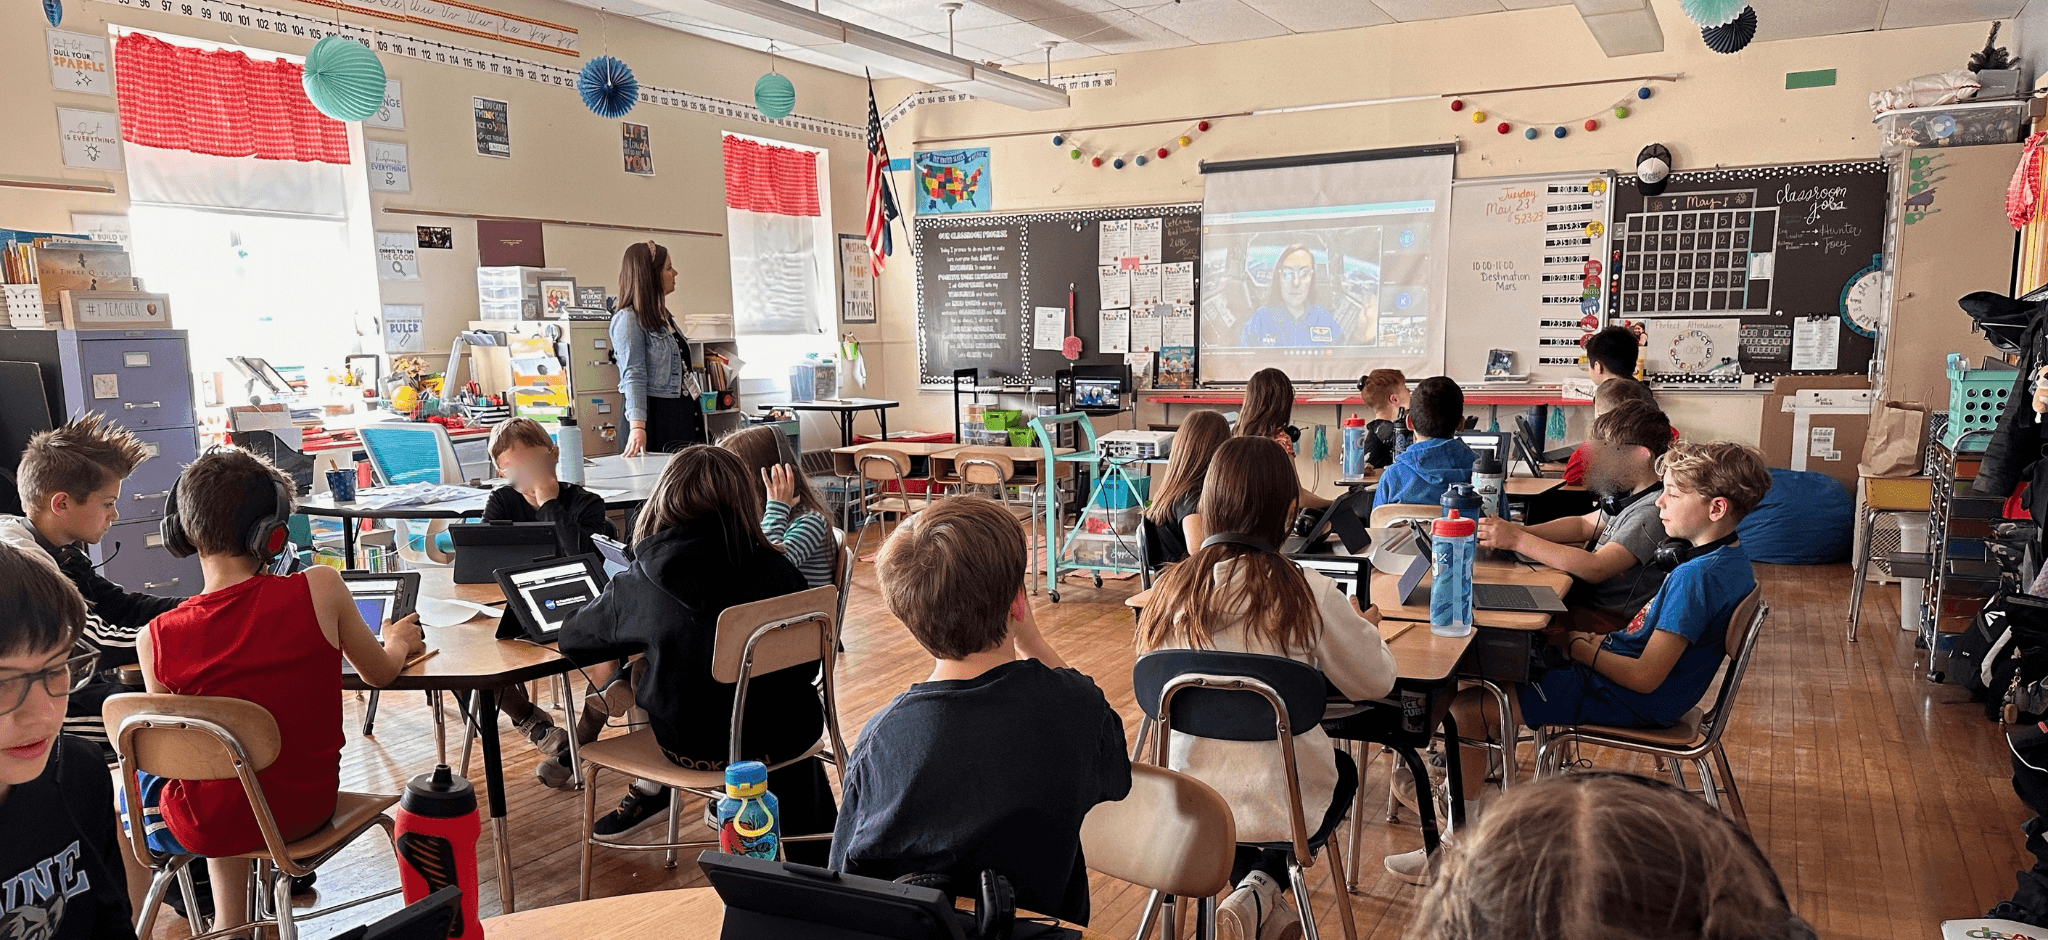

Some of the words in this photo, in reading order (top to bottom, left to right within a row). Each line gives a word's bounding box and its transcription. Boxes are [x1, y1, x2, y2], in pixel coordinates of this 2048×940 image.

[162, 0, 172, 12] 97
[181, 4, 192, 15] 98
[201, 8, 212, 19] 99
[219, 11, 232, 23] 100
[238, 15, 250, 27] 101
[256, 18, 269, 30] 102
[274, 22, 287, 33] 103
[291, 25, 304, 36] 104
[309, 28, 321, 40] 105
[53, 49, 70, 57] DULL
[72, 52, 91, 60] YOUR
[377, 40, 388, 51] 109
[393, 44, 403, 54] 110
[407, 47, 416, 57] 111
[421, 49, 431, 60] 112
[435, 52, 445, 63] 113
[449, 55, 459, 65] 114
[463, 58, 472, 68] 115
[476, 60, 486, 71] 116
[490, 63, 498, 73] 117
[53, 56, 105, 73] SPARKLE
[383, 98, 401, 109] NGE
[624, 123, 648, 140] LIFE
[73, 135, 116, 144] EVERYTHING
[371, 163, 407, 173] EVERYTHING
[625, 155, 651, 171] YOU
[1498, 187, 1538, 203] Tuesday
[1776, 183, 1847, 204] Classroom
[1686, 195, 1721, 210] May
[1486, 202, 1514, 222] May
[1806, 197, 1848, 225] jobs
[1666, 217, 1674, 228] 2
[1684, 217, 1692, 229] 3
[1704, 216, 1710, 226] 4
[1720, 215, 1729, 226] 5
[1738, 214, 1745, 224] 6
[1629, 237, 1637, 246] 7
[1649, 236, 1655, 245] 8
[1665, 236, 1672, 244] 9
[1682, 236, 1690, 245] 10
[1700, 236, 1707, 244] 11
[1717, 235, 1726, 244] 12
[1736, 233, 1746, 244] 13
[1627, 258, 1636, 267] 14
[1646, 257, 1655, 267] 15
[1662, 257, 1670, 266] 16
[1680, 256, 1689, 266] 17
[1699, 256, 1708, 265] 18
[1717, 255, 1725, 264] 19
[1733, 256, 1744, 265] 20
[88, 269, 129, 278] QUESTION
[1480, 270, 1531, 282] Destination
[1495, 281, 1517, 291] Mars
[1626, 278, 1635, 287] 21
[1644, 277, 1654, 287] 22
[1661, 276, 1672, 286] 23
[1678, 276, 1689, 285] 24
[1696, 275, 1707, 285] 25
[1714, 275, 1725, 284] 26
[1732, 275, 1742, 284] 27
[850, 290, 860, 299] YOU
[860, 290, 869, 299] ARE
[1625, 297, 1635, 306] 28
[1643, 296, 1652, 306] 29
[1660, 296, 1669, 305] 30
[1677, 295, 1685, 305] 31
[86, 302, 101, 317] #1
[846, 301, 873, 317] TRYING
[390, 323, 419, 334] RULER
[1402, 701, 1418, 709] ICE
[0, 840, 91, 918] INE
[1252, 874, 1268, 887] NIKE
